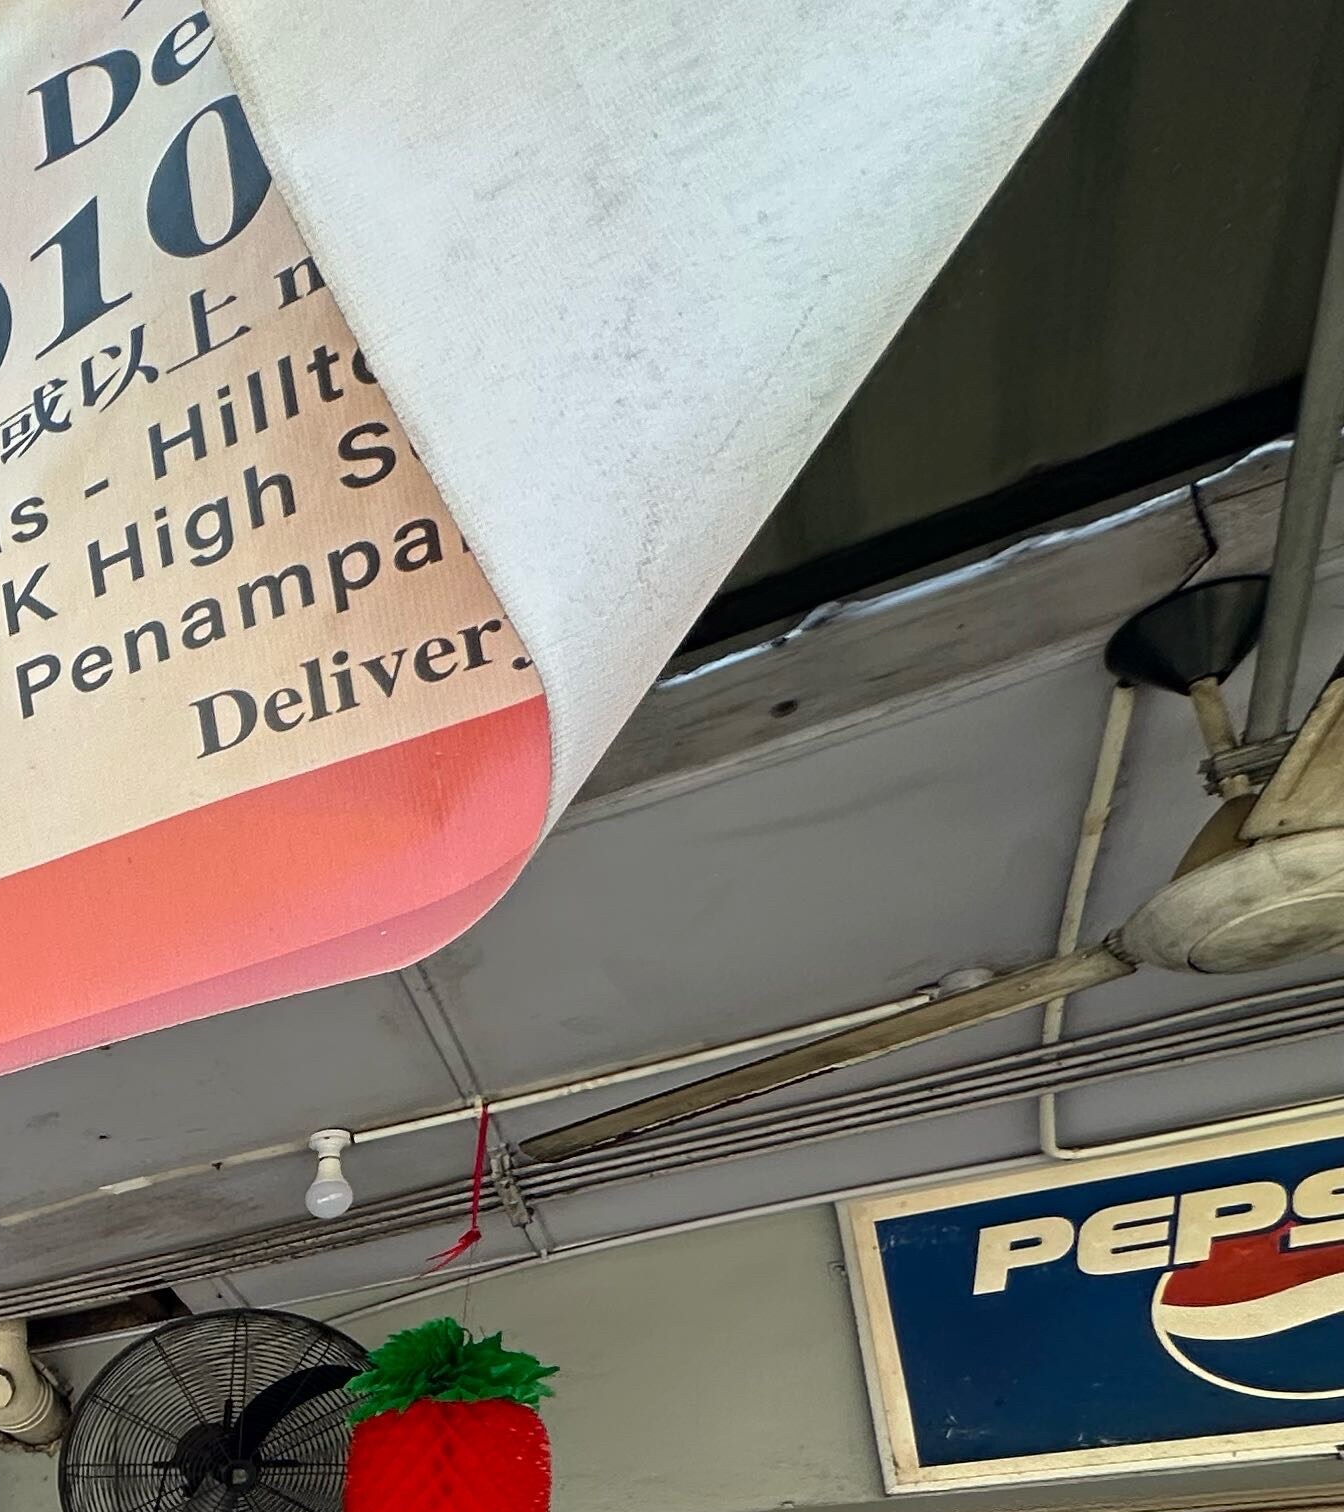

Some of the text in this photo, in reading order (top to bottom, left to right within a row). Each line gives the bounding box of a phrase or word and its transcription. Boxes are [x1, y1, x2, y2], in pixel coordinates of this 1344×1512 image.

[87, 466, 297, 598] High
[337, 421, 421, 490] S
[13, 516, 471, 720] Penampa
